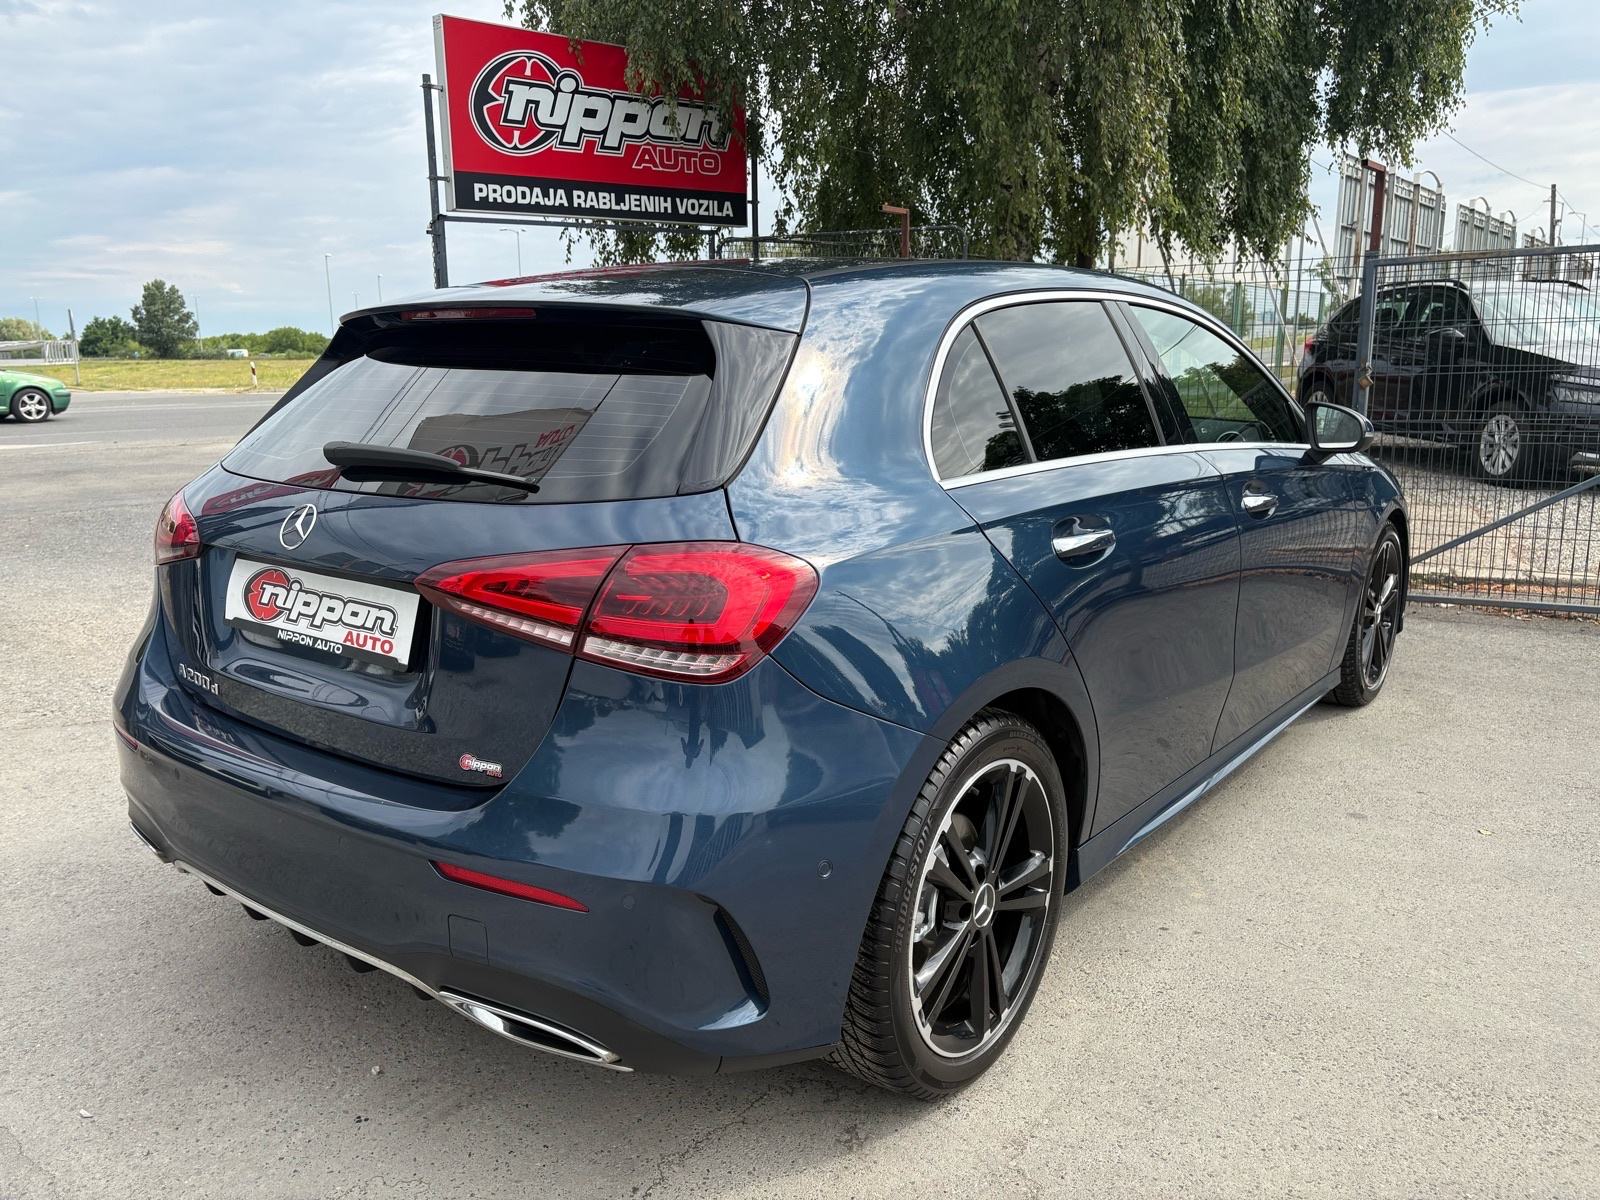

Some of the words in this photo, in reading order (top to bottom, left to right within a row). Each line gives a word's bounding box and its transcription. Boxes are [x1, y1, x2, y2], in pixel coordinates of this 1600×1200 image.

[502, 72, 731, 152] nippon
[633, 147, 722, 175] AUTO
[473, 182, 569, 207] PRODAJA
[572, 190, 672, 213] RABLJENIH
[675, 197, 734, 218] VOZILA
[259, 581, 399, 637] nippon
[277, 629, 314, 647] NIPPON
[314, 638, 343, 654] AUTO
[342, 631, 394, 655] AUTO
[464, 758, 503, 773] nippon
